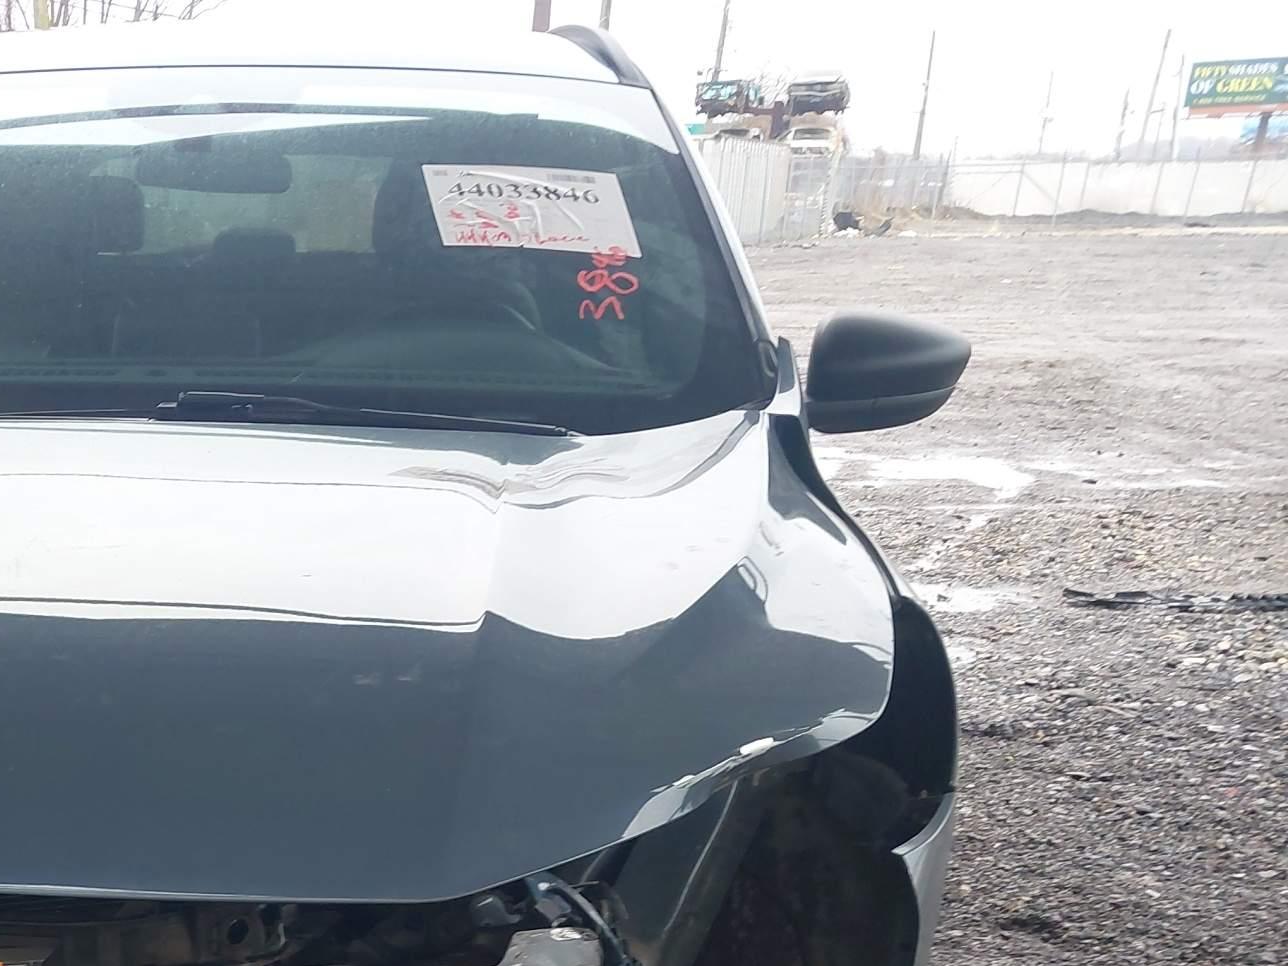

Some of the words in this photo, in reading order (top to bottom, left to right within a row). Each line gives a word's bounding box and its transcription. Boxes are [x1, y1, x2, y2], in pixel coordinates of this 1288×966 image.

[1190, 79, 1215, 94] OF
[1216, 76, 1272, 93] GREEN
[448, 182, 600, 204] 44033846
